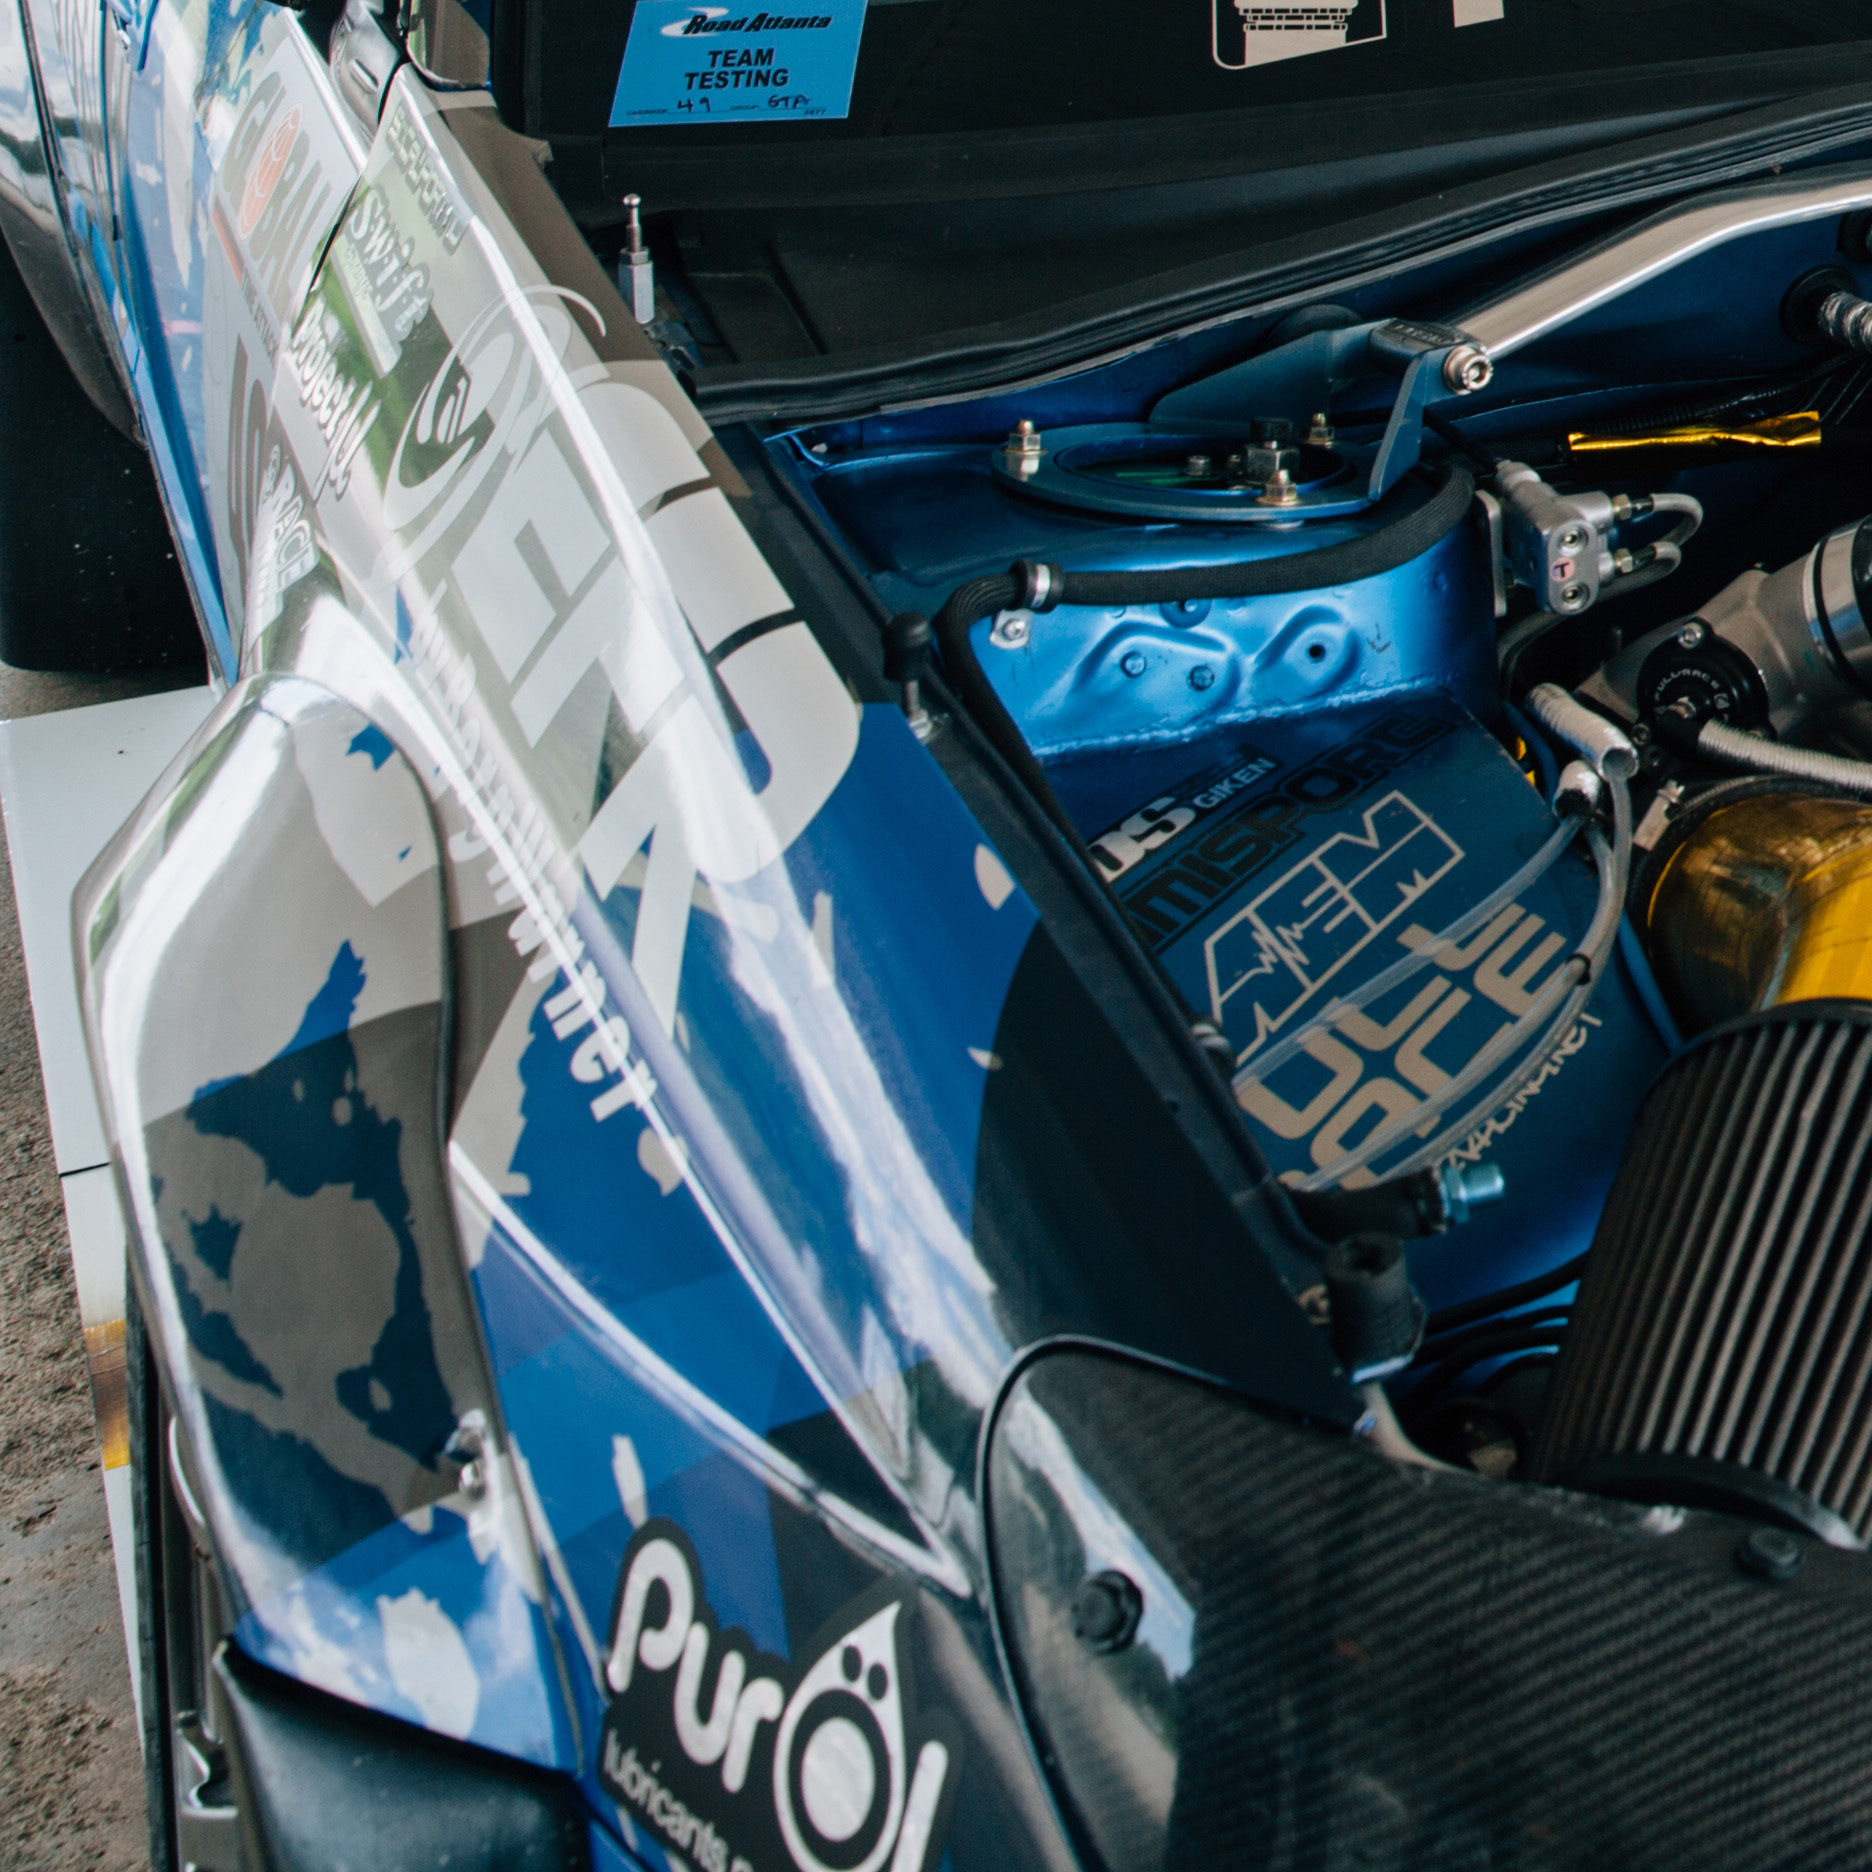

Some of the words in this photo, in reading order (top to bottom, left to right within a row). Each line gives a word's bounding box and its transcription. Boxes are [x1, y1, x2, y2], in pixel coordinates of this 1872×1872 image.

[683, 14, 750, 35] Road
[744, 12, 833, 32] Atlanta
[708, 48, 775, 68] TEAM
[684, 68, 789, 90] TESTING
[1193, 757, 1278, 808] GIKEN
